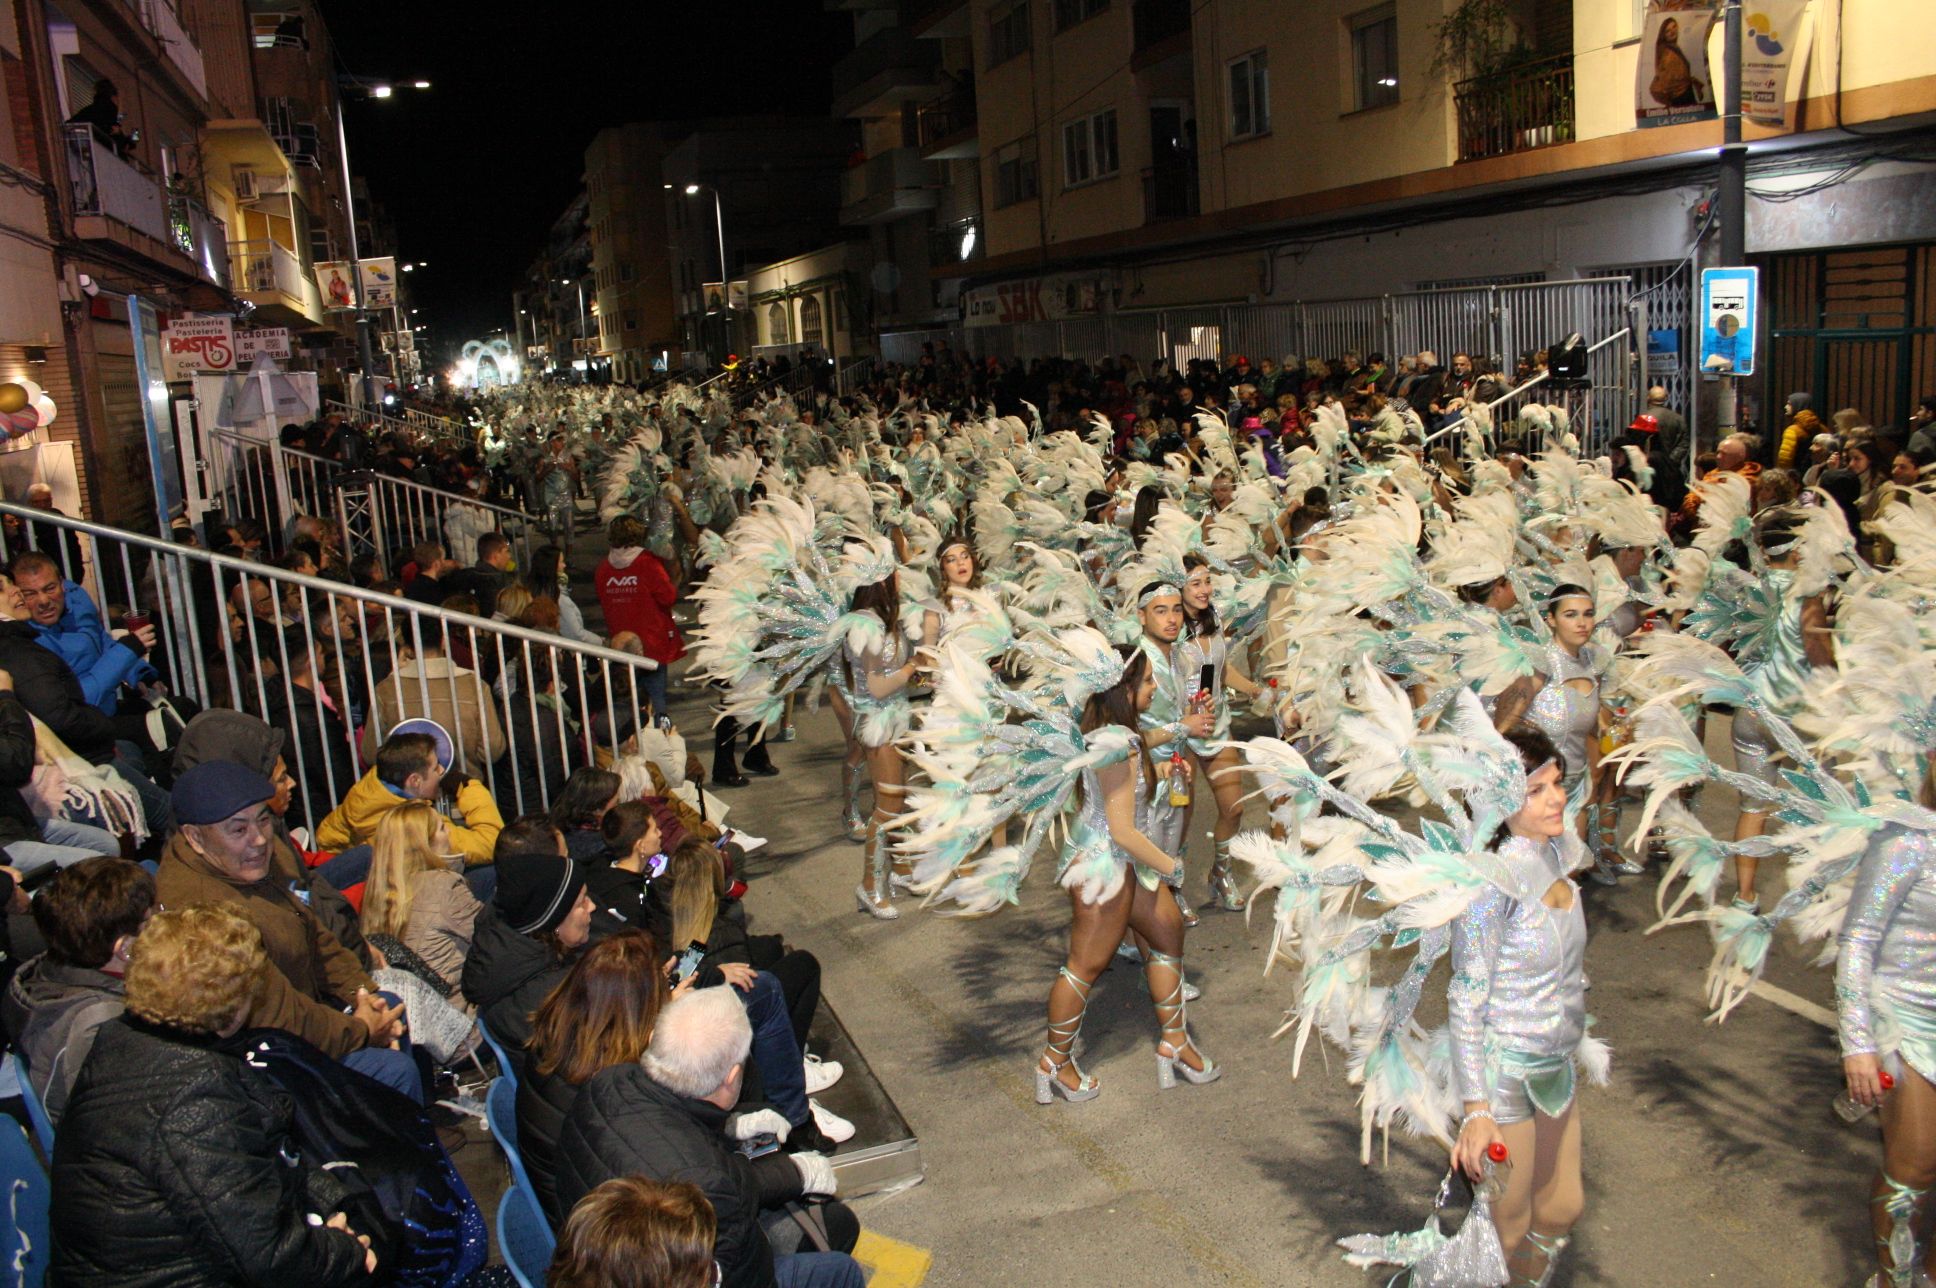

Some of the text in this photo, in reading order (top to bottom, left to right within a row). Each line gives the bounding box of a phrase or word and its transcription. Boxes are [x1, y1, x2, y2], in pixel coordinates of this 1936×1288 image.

[172, 320, 224, 328] Pastisseria
[176, 327, 223, 336] Pasteleria
[235, 329, 287, 339] ACADEMIA
[244, 342, 254, 350] DE
[1647, 353, 1675, 361] QUILA
